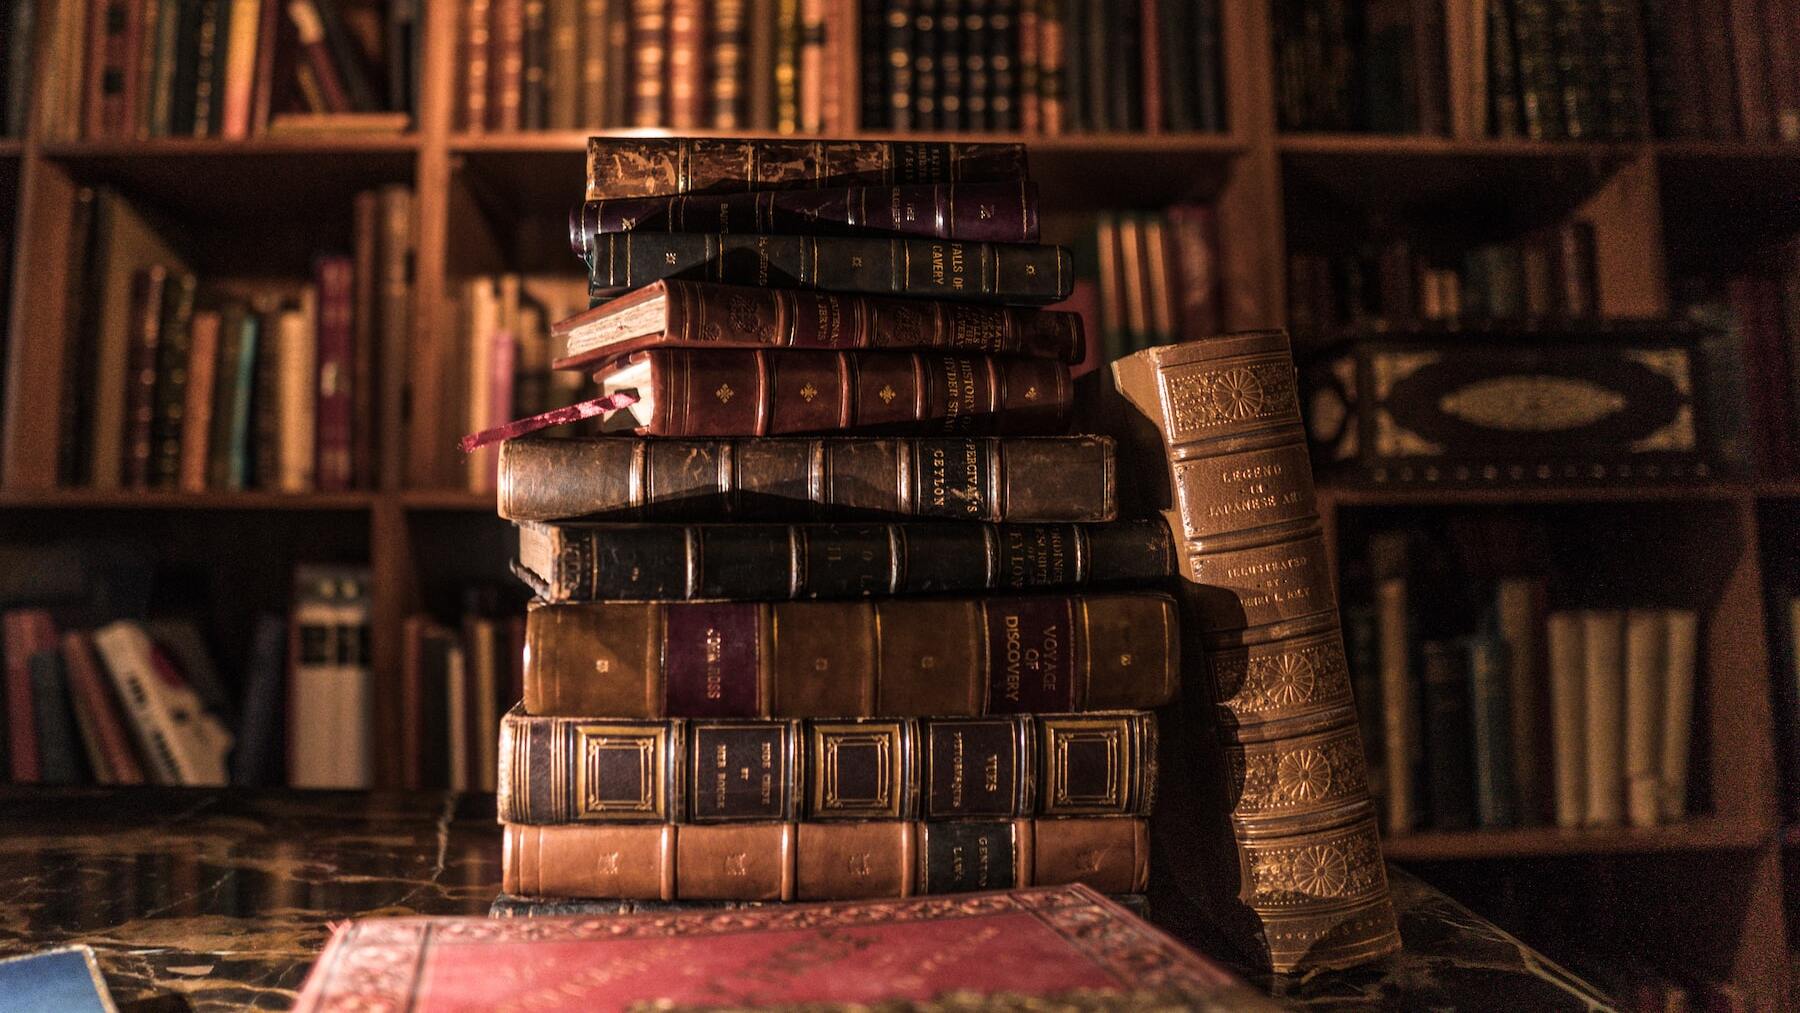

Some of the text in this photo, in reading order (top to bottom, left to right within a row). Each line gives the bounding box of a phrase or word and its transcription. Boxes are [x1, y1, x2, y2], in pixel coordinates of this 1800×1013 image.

[932, 244, 944, 286] CAVERY
[952, 243, 964, 290] FALLS OF
[959, 359, 976, 412] HISTORY
[933, 448, 945, 507] CEYLON
[966, 442, 978, 513] PERCIVAL'S
[1208, 495, 1278, 518] JAPANESE
[1227, 556, 1308, 579] ILLUSTRATED
[1266, 577, 1280, 588] BY
[1004, 615, 1023, 702] DISCOVERY
[1025, 648, 1040, 673] OF
[1042, 624, 1057, 691] VOYAGE
[707, 665, 721, 701] ROSS
[716, 743, 728, 808] MER ROUGE
[984, 752, 998, 793] VUES
[952, 845, 963, 882] LAWS
